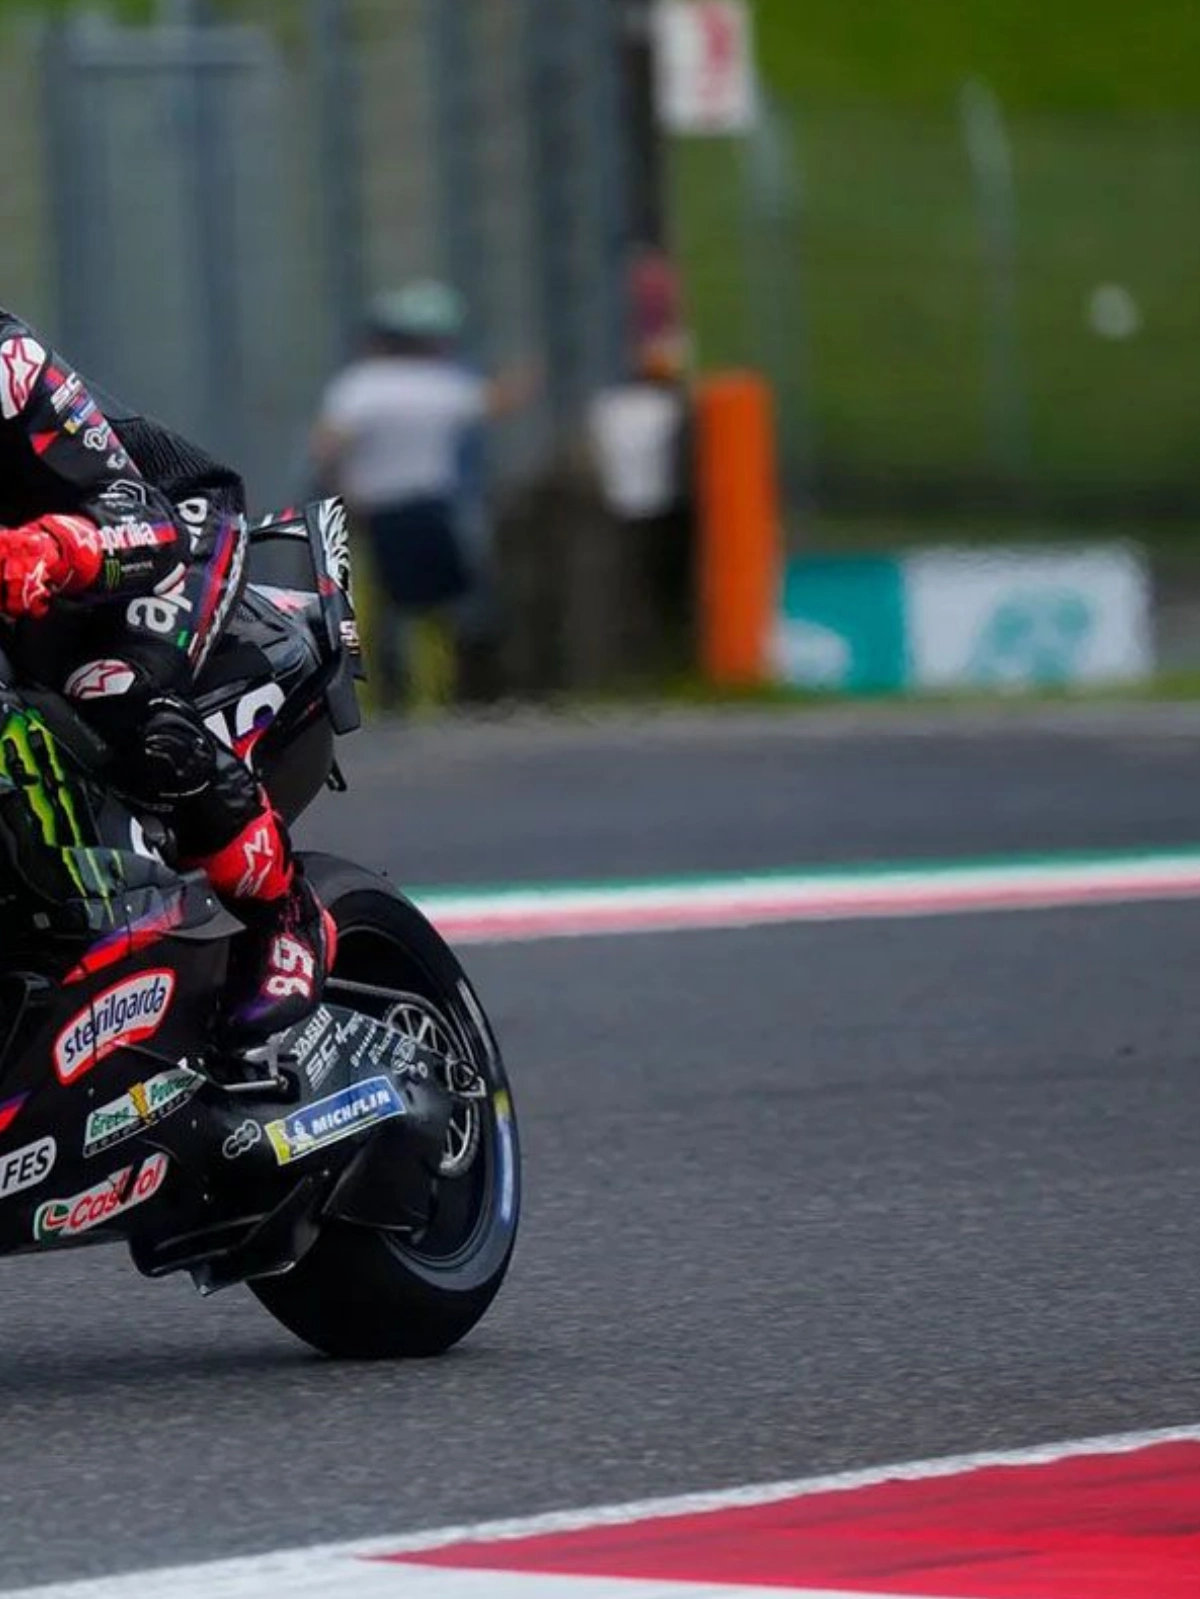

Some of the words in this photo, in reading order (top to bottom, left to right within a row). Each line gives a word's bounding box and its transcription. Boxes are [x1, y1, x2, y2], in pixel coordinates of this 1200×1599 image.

[64, 977, 166, 1063] sterilgarda
[3, 1145, 50, 1189] FES
[69, 1158, 163, 1229] Castol
